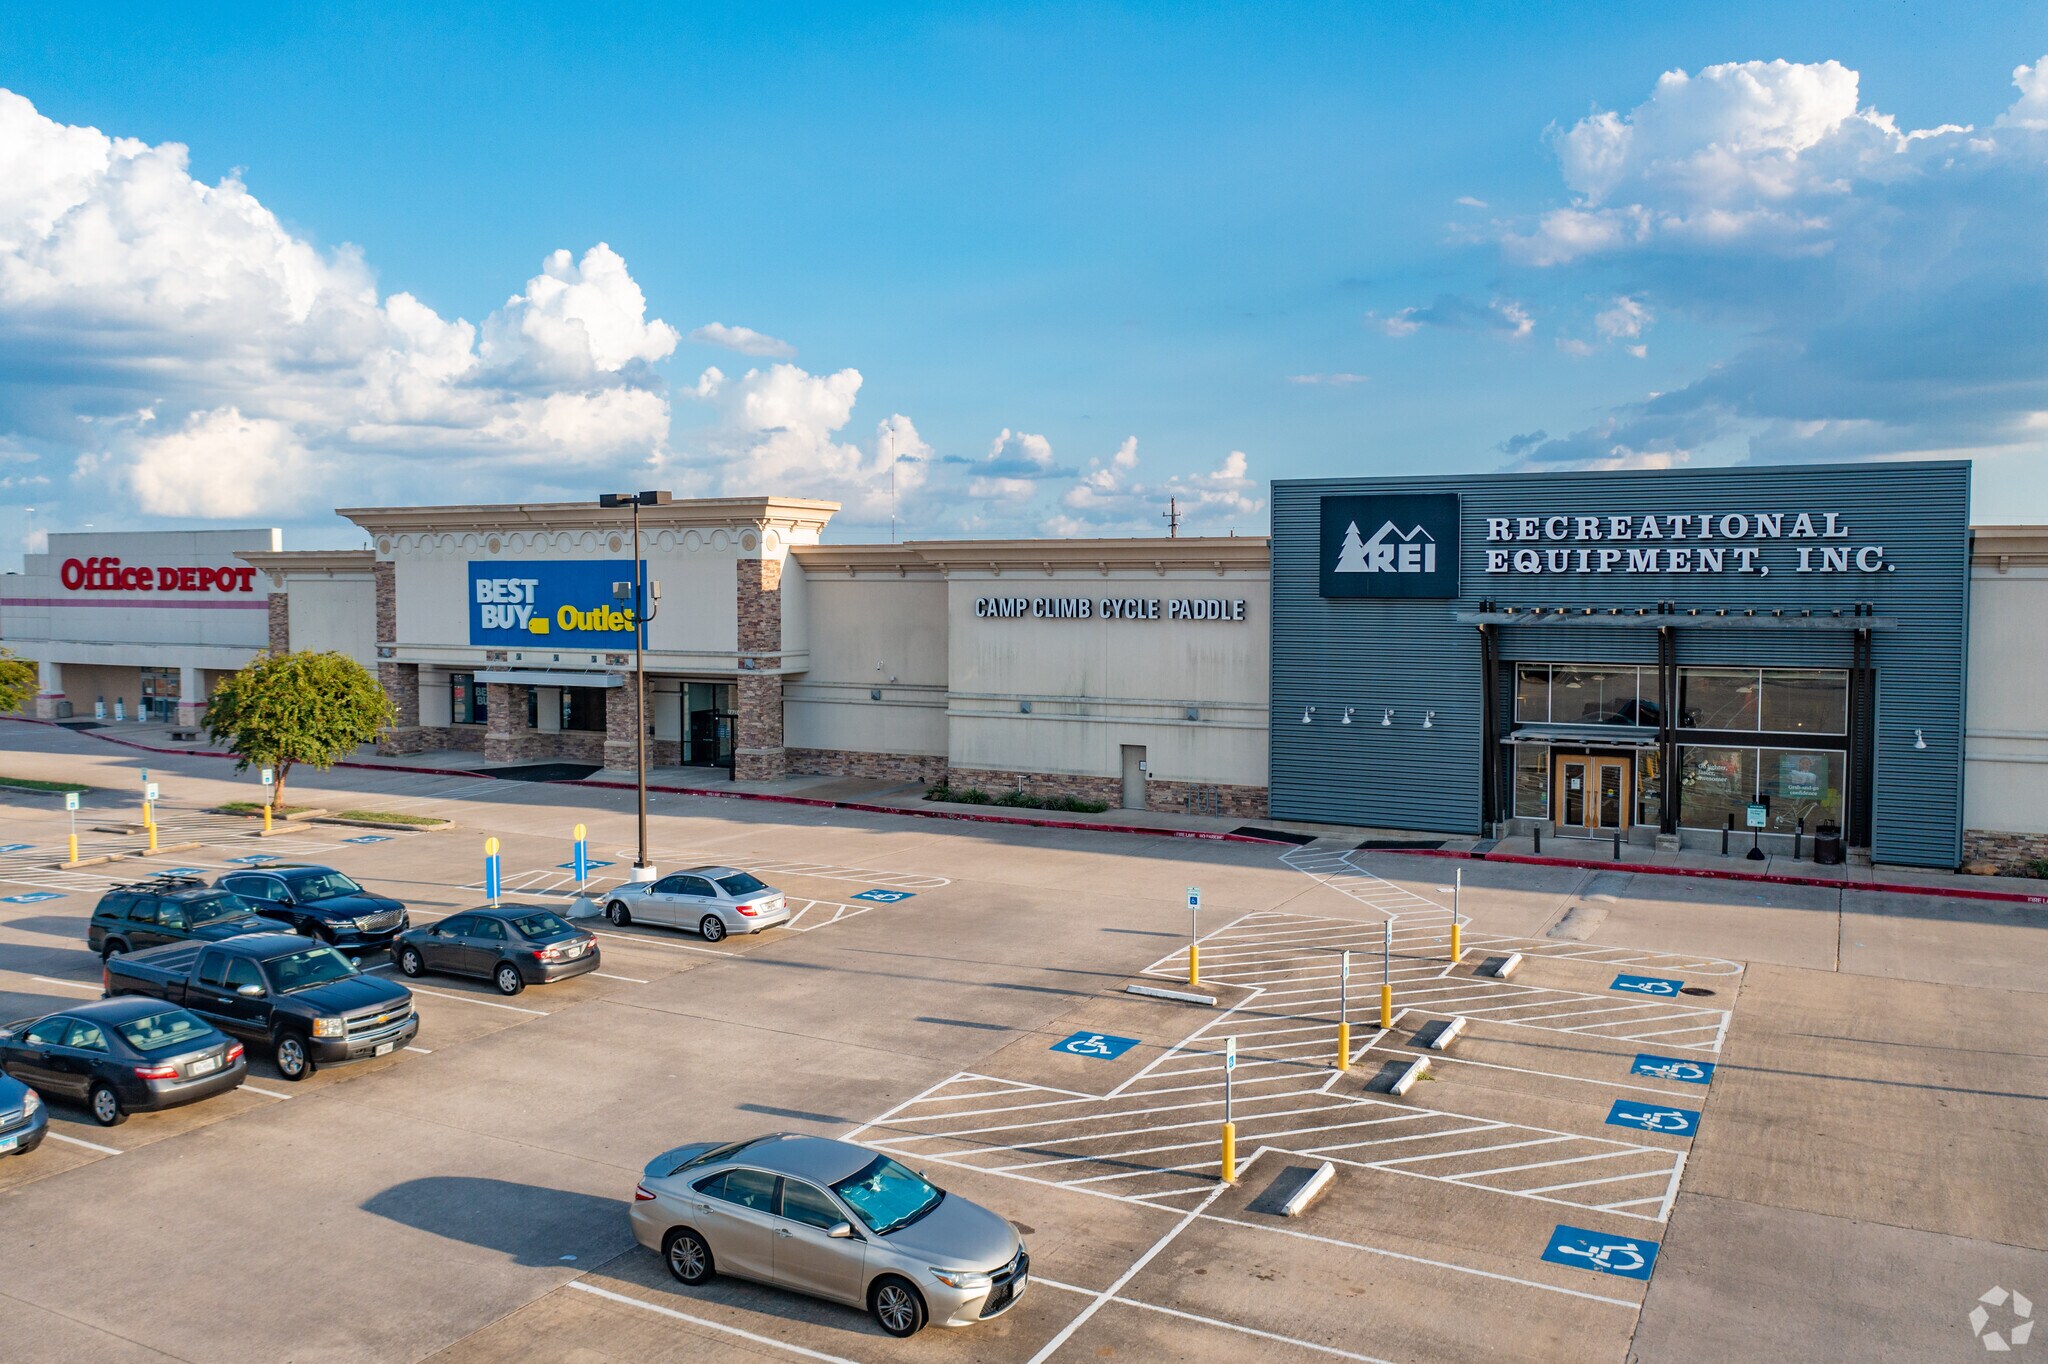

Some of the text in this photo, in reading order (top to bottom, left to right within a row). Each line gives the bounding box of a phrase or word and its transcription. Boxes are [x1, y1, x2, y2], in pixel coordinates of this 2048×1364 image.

[1486, 513, 1848, 541] RECREATIONAL
[1367, 542, 1436, 573] REI
[1485, 546, 1896, 577] EQUIPMENT, INC.
[61, 557, 256, 592] Office DEPOT
[476, 578, 539, 604] BEST
[481, 604, 534, 630] BUY
[557, 605, 636, 632] Outlet
[975, 598, 1246, 621] CAMP CLIMB CYCLE PADDLE
[475, 687, 488, 697] BE
